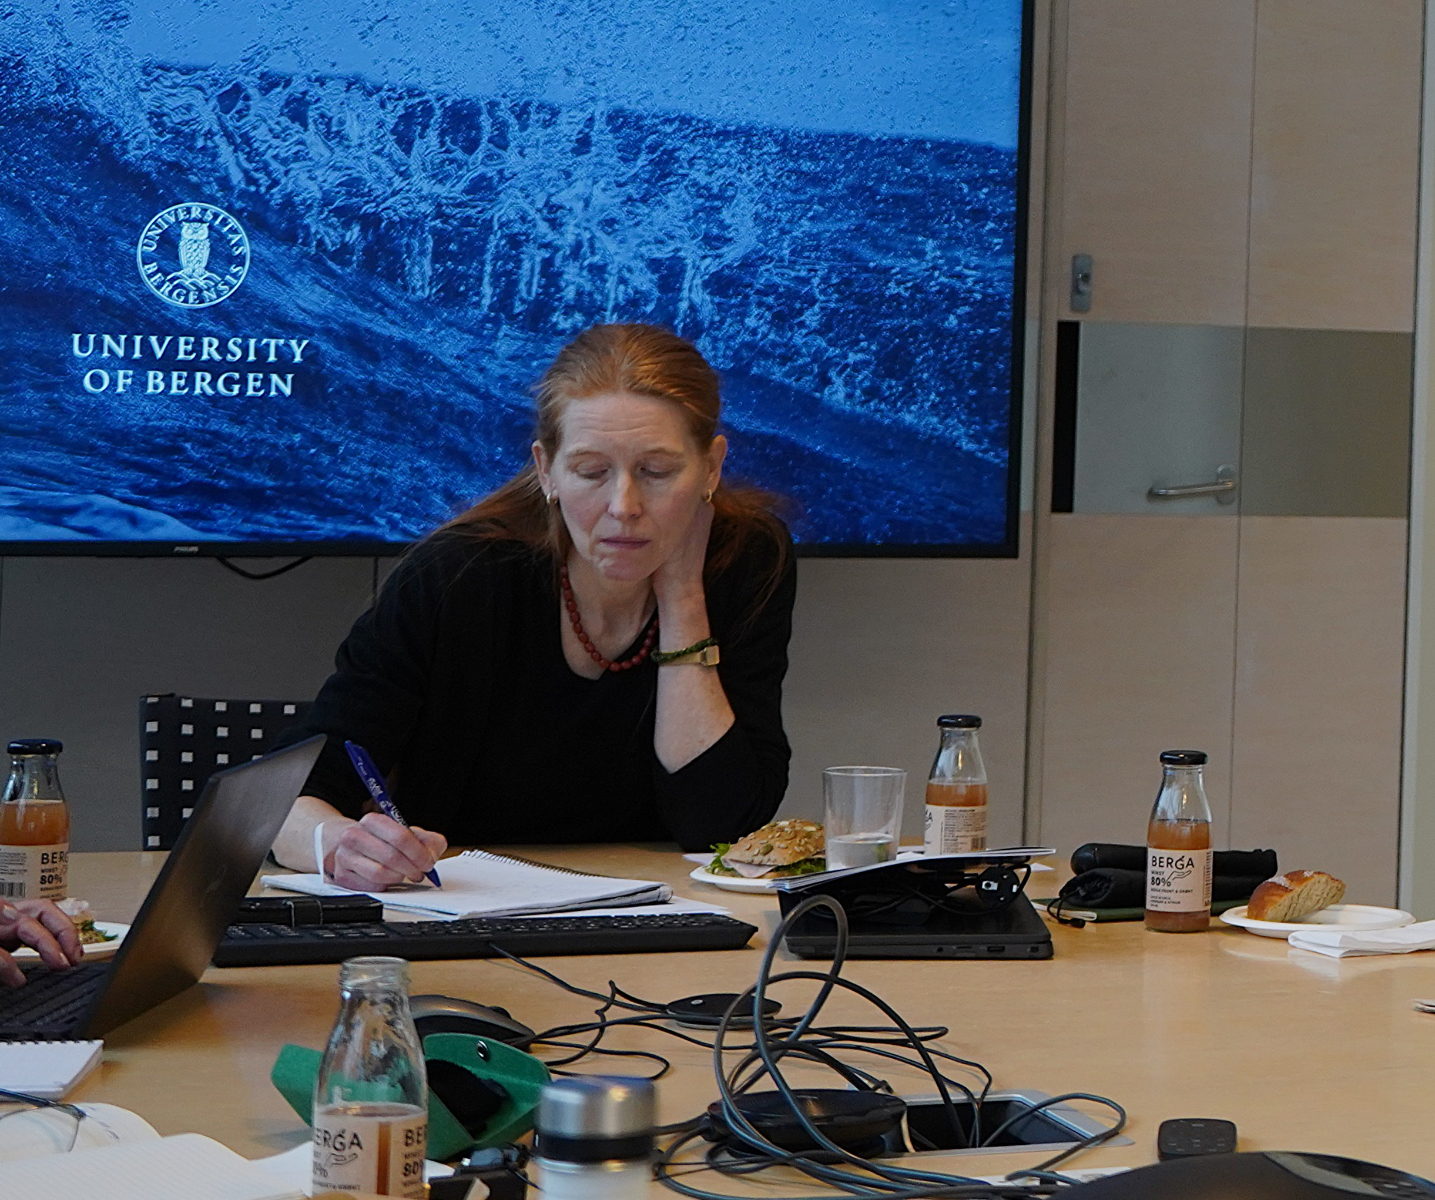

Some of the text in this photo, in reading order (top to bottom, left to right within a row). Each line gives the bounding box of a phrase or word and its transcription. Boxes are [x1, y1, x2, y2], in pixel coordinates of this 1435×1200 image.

[143, 205, 246, 257] UNIVERSITAS
[143, 261, 245, 305] BERGENSIS
[72, 332, 310, 364] UNIVERSITY
[83, 368, 295, 398] OF BERGEN
[1151, 855, 1195, 871] BERGA
[1151, 876, 1171, 887] 80%
[313, 1127, 363, 1152] ERGA
